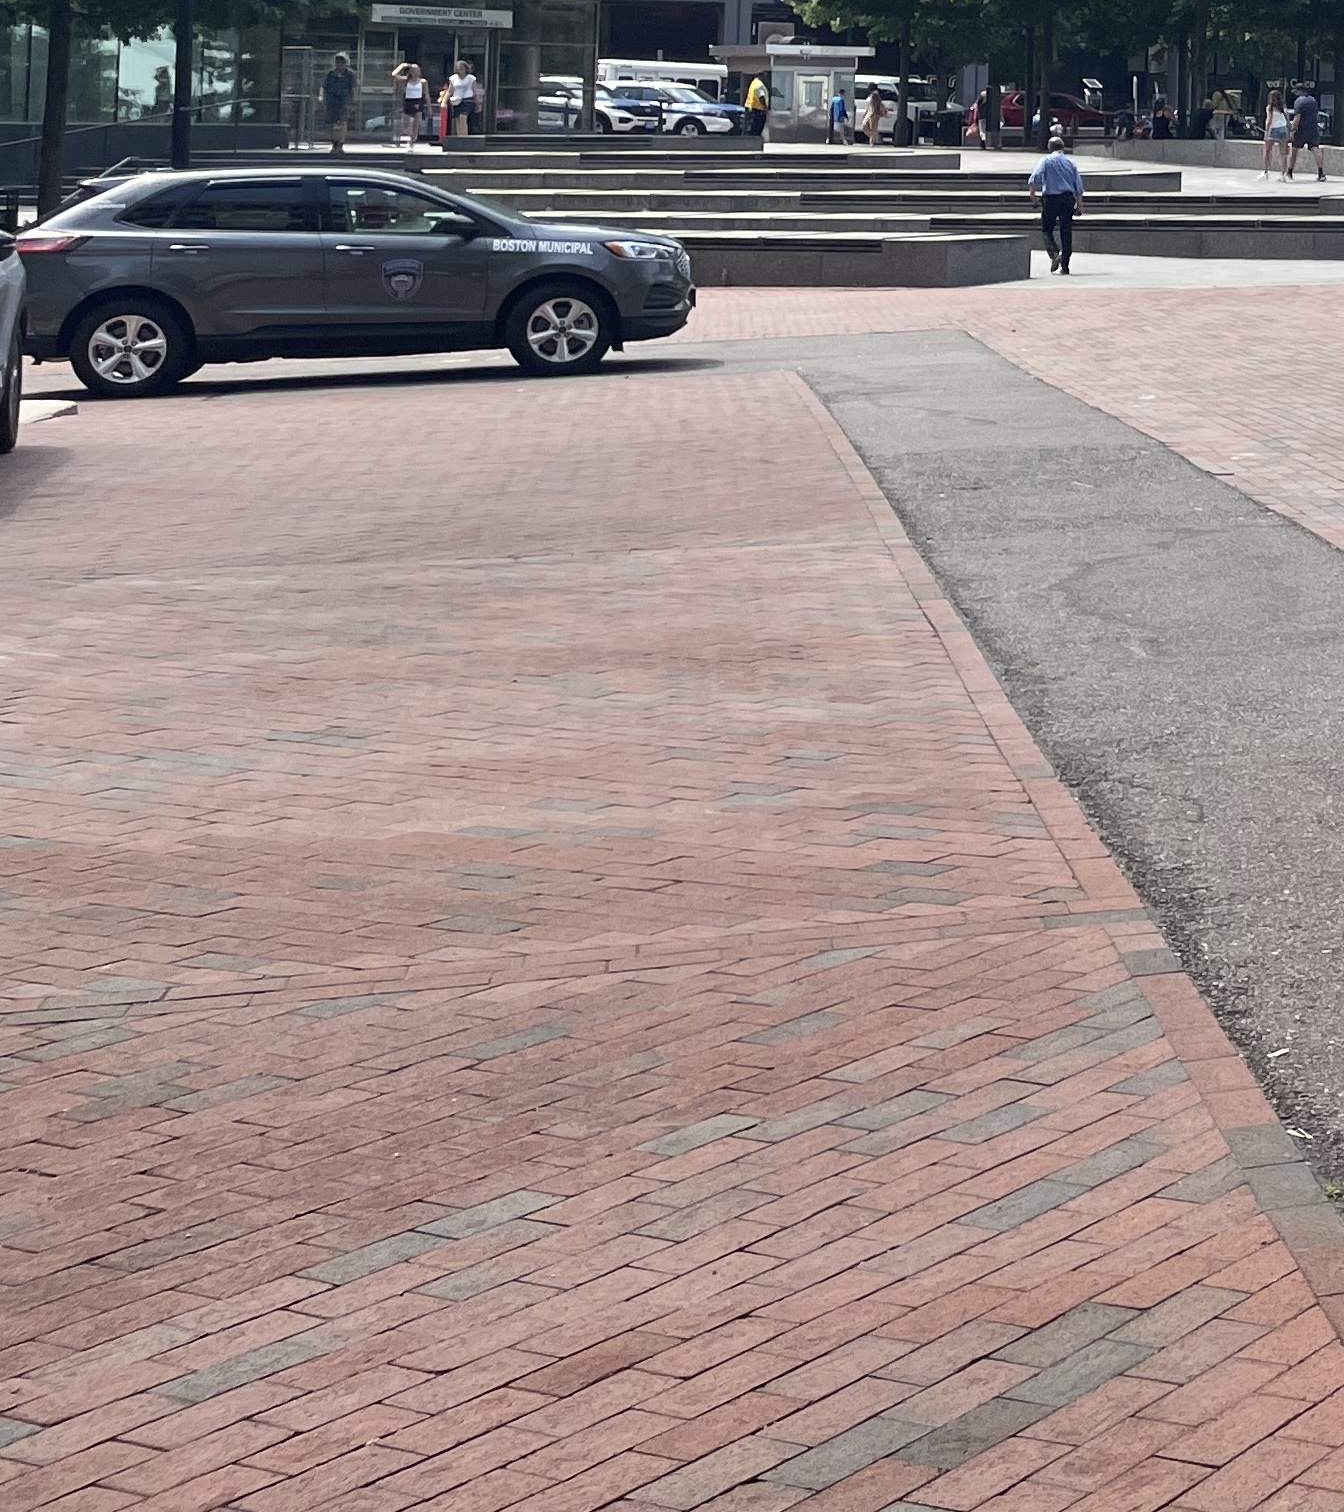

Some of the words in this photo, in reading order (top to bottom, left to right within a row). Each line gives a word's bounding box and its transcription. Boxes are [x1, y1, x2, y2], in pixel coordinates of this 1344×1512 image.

[399, 6, 451, 17] GOVERNMENT
[453, 9, 483, 18] CENTER
[492, 238, 537, 252] BOSTON
[538, 240, 594, 255] MUNICIPAL
